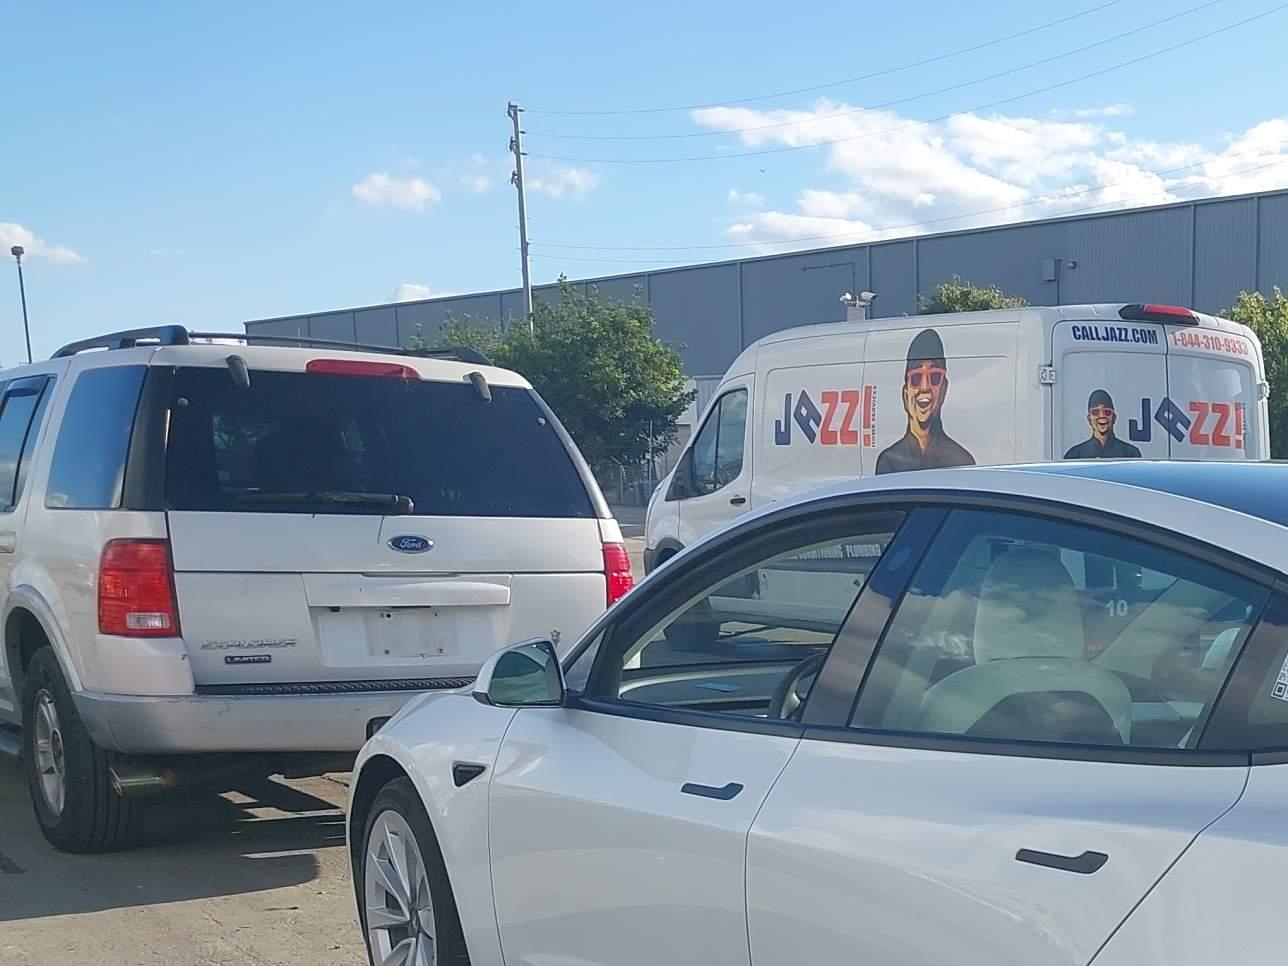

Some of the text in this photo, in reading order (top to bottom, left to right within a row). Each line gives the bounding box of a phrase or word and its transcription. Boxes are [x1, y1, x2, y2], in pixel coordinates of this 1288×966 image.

[1071, 325, 1159, 345] CALLJAZZ.COM
[1171, 332, 1249, 356] 1-844-310-9333
[774, 385, 873, 448] JAZZ!
[1128, 397, 1243, 449] JAZZ!
[1104, 599, 1129, 617] 10
